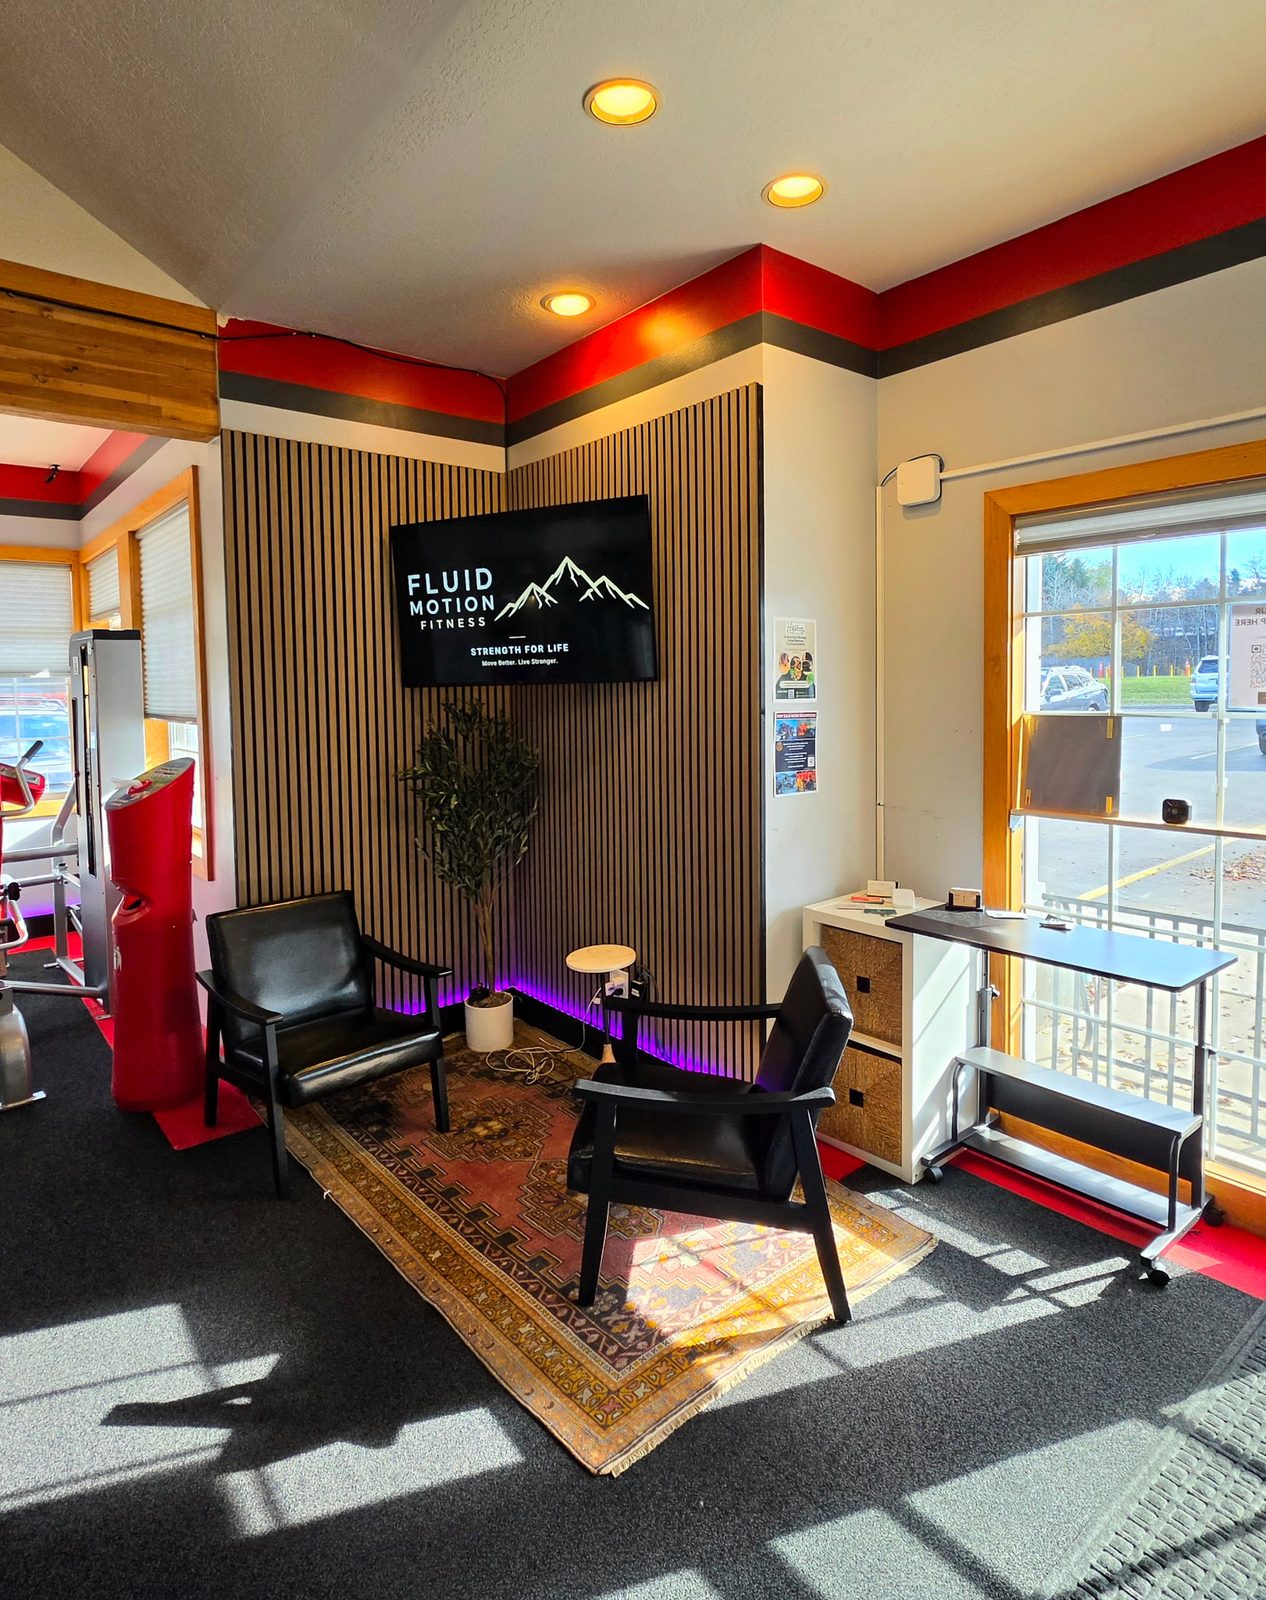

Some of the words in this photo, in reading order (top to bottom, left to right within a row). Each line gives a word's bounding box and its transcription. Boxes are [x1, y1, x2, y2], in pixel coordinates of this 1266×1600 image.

[407, 567, 493, 596] FLUID
[409, 594, 495, 616] MOTION
[420, 617, 486, 630] FITNESS
[470, 645, 522, 656] STRENGTH
[524, 644, 545, 654] FOR
[547, 643, 569, 653] LIFE
[498, 658, 517, 667] Better.
[517, 658, 530, 666] Live
[531, 657, 559, 667] Stronger.
